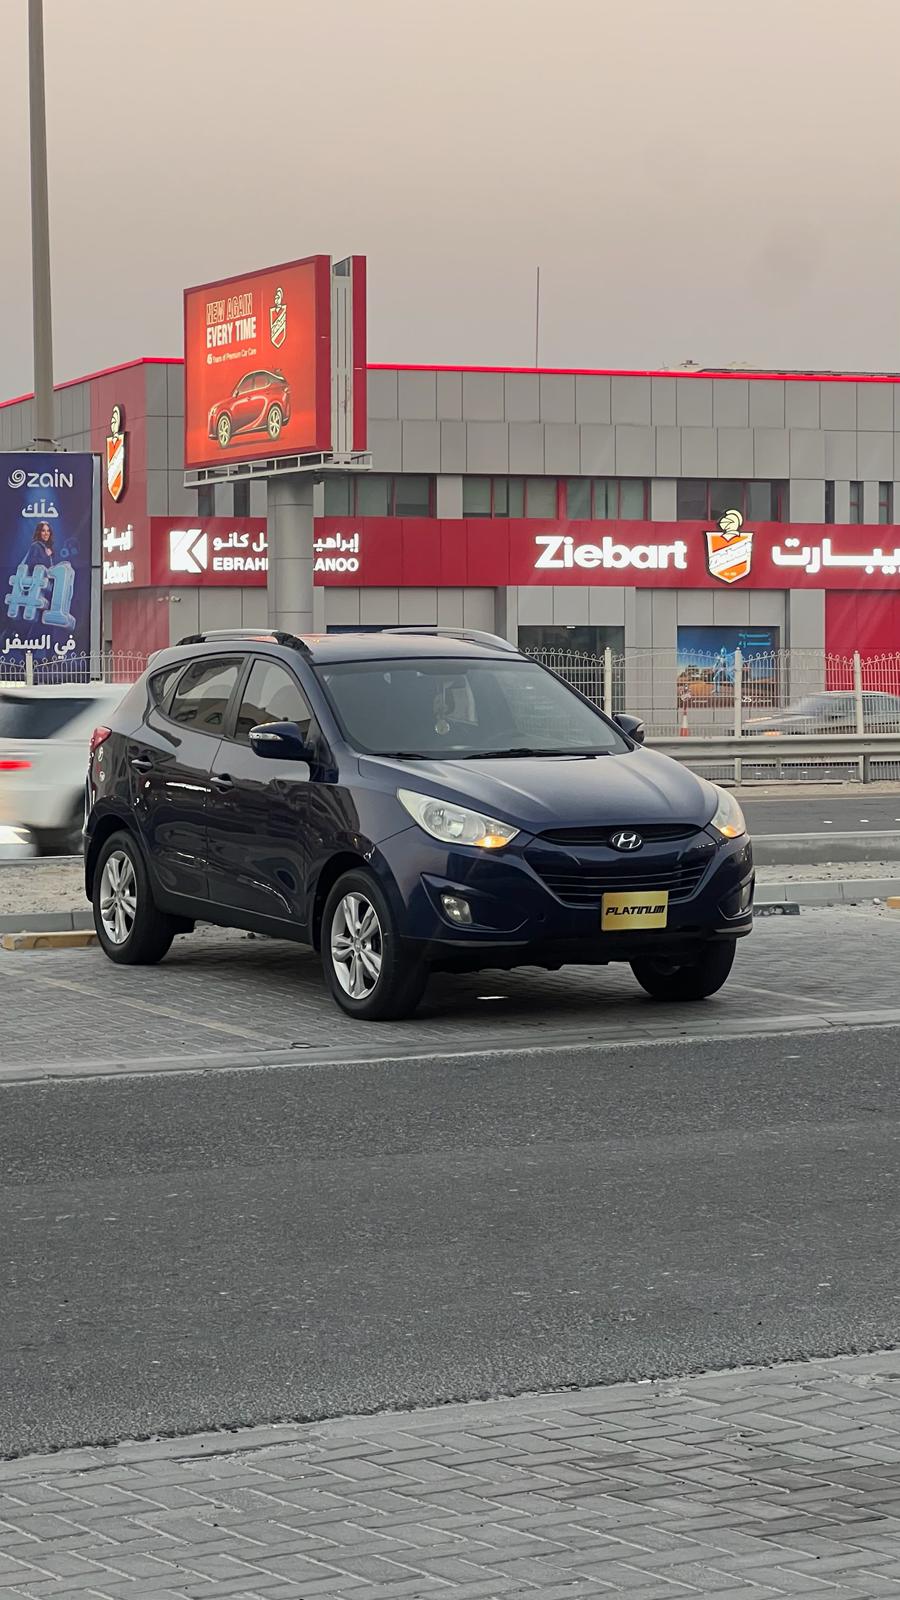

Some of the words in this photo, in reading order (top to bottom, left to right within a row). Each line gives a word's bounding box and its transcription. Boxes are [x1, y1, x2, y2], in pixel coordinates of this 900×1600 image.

[207, 300, 225, 325] NEW
[227, 292, 252, 320] AGAIN
[207, 322, 233, 348] EVERY
[235, 316, 256, 342] TIME
[27, 468, 73, 488] zain
[212, 557, 268, 571] EBRAHI
[313, 557, 359, 571] ANOO
[534, 536, 687, 570] Ziebart
[771, 538, 900, 575] يبارت
[4, 560, 76, 629] #1
[2, 633, 51, 654] السفر
[54, 634, 76, 660] في
[605, 905, 666, 916] PLATINUM
